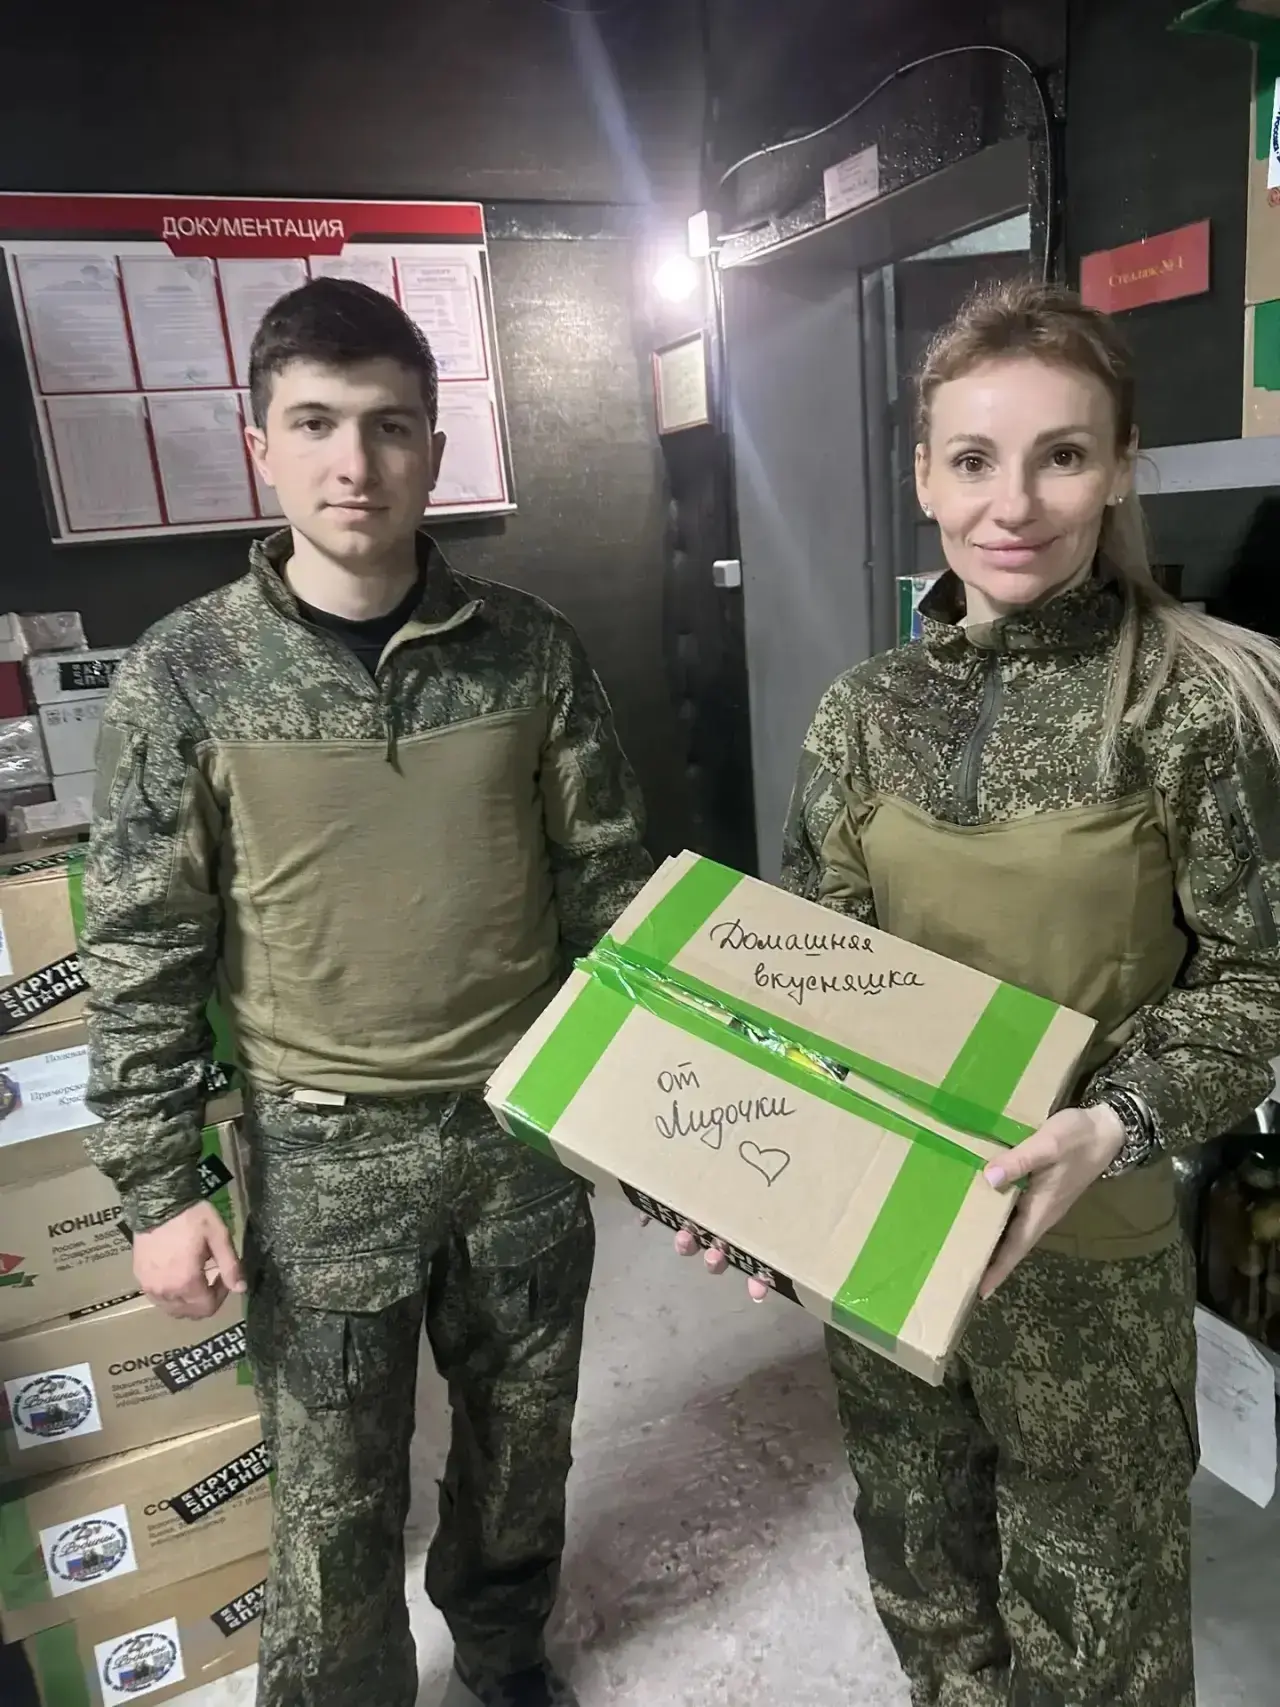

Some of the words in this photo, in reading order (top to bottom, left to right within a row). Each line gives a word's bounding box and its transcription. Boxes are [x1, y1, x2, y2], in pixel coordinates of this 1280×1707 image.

[162, 216, 345, 241] ДОКУМЕНТАЦИЯ
[710, 918, 875, 954] Домашняя
[754, 962, 925, 1006] вкусняшка
[657, 1062, 700, 1093] от
[655, 1096, 798, 1150] Лидочки
[179, 1324, 247, 1368] КРУТЫ
[193, 1444, 268, 1497] КРУТЫХ
